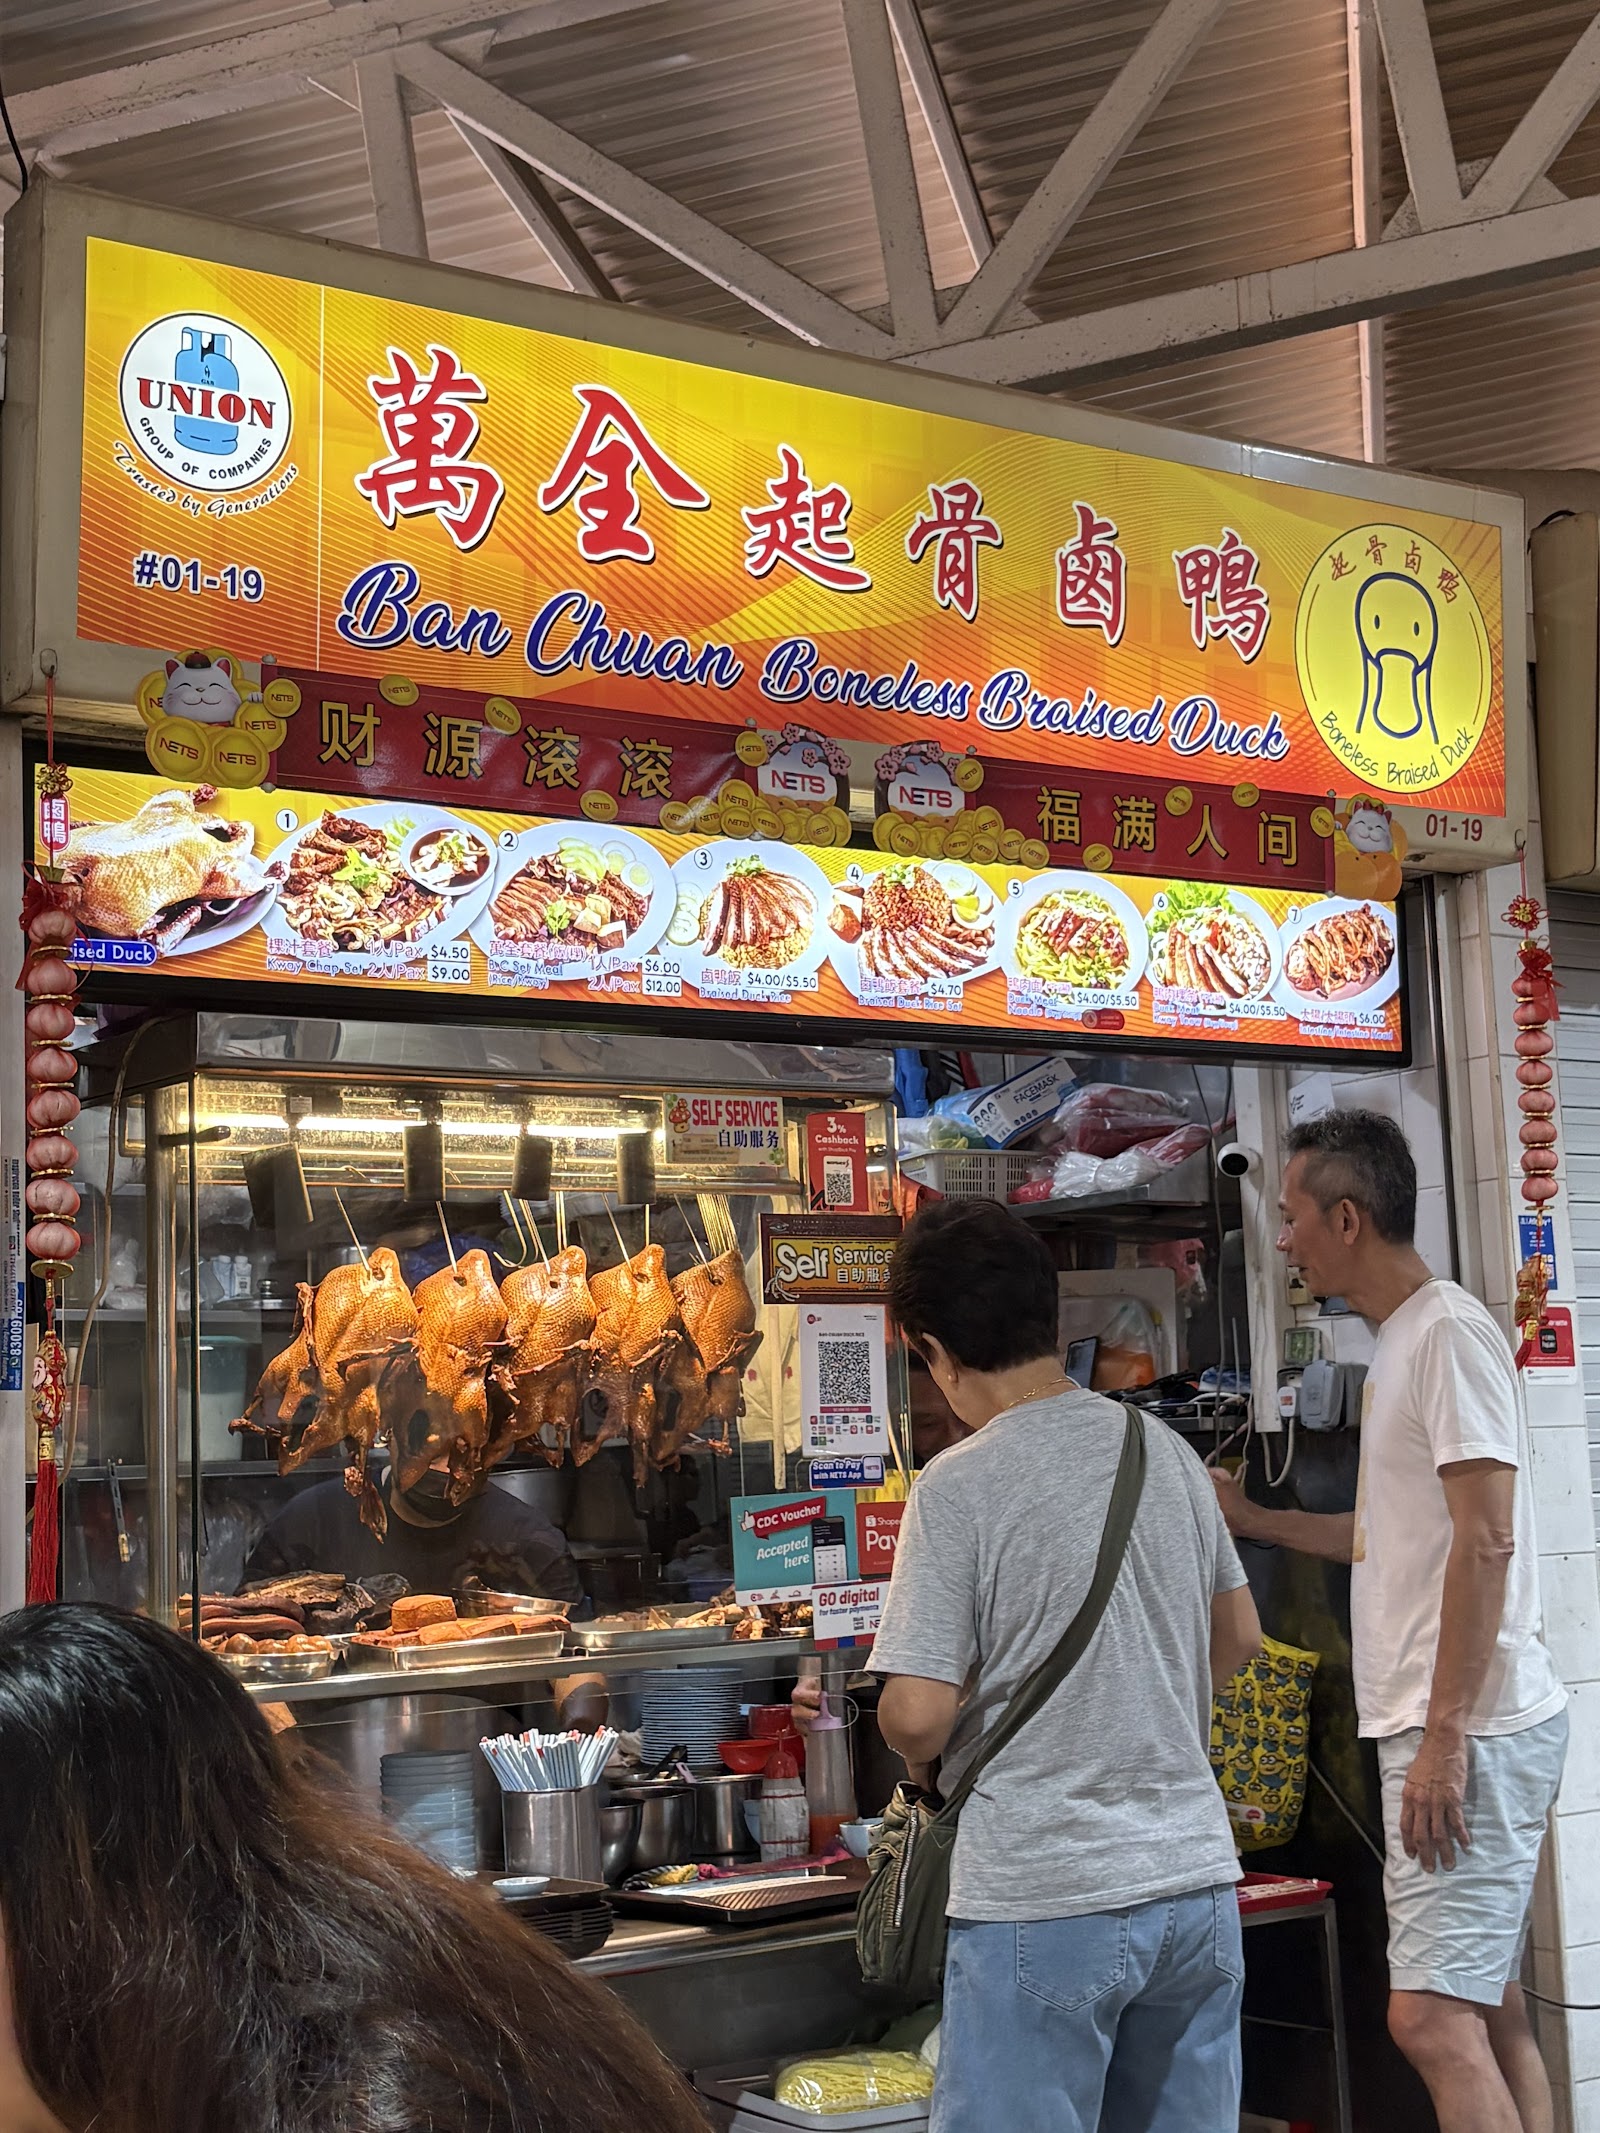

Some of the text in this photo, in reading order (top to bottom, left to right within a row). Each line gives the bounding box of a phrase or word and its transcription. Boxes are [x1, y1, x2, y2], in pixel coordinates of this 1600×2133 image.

[137, 377, 276, 429] UNION
[140, 417, 272, 479] GROUP OF COMPANIES
[114, 441, 299, 518] Trusted by Generations
[133, 550, 265, 602] #01-19
[336, 561, 1291, 763] Ban Chuan Boneless Braised Duck
[491, 706, 515, 725] NETS
[245, 719, 277, 732] NETS
[159, 737, 199, 760] NETS
[319, 700, 674, 801] 财源滚滚
[1320, 710, 1475, 785] Boneless Braised Duck
[218, 752, 257, 766] NETS
[771, 769, 826, 794] NETS
[899, 786, 953, 808] NETS
[1036, 785, 1298, 867] 福满人间
[1426, 813, 1484, 843] 01-19
[112, 944, 152, 962] Duck
[430, 945, 469, 960] $4.50
[267, 957, 302, 973] Kway
[306, 959, 339, 975] Chap
[344, 962, 363, 975] Set
[431, 966, 470, 981] $9.00
[513, 960, 532, 975] Set
[534, 963, 563, 977] Meal
[644, 959, 681, 975] $6.00
[645, 980, 681, 995] $12.00
[747, 972, 817, 989] $4.00/$5.50
[930, 983, 962, 996] $4.70
[700, 987, 738, 999] Braised
[742, 989, 768, 1001] Duck
[859, 994, 895, 1007] Braised
[898, 995, 922, 1008] Duck
[1076, 992, 1137, 1008] $4.00/$5.50
[1229, 1003, 1286, 1017] $4.00/$5.50
[1359, 1012, 1385, 1024] $6.00
[1013, 1073, 1060, 1104] FACEMASK
[692, 1098, 779, 1128] SELF SERVICE
[826, 1116, 847, 1134] 3%
[718, 1129, 780, 1149] 自助服务
[815, 1134, 860, 1145] Cashback
[775, 1242, 895, 1284] Self Service
[813, 1460, 861, 1471] Scan to Pay
[756, 1504, 821, 1529] CDC Voucher
[877, 1517, 901, 1528] Shope
[756, 1536, 809, 1561] Accepted
[784, 1553, 810, 1569] here
[819, 1587, 879, 1607] GO digital
[869, 1619, 881, 1630] NE
